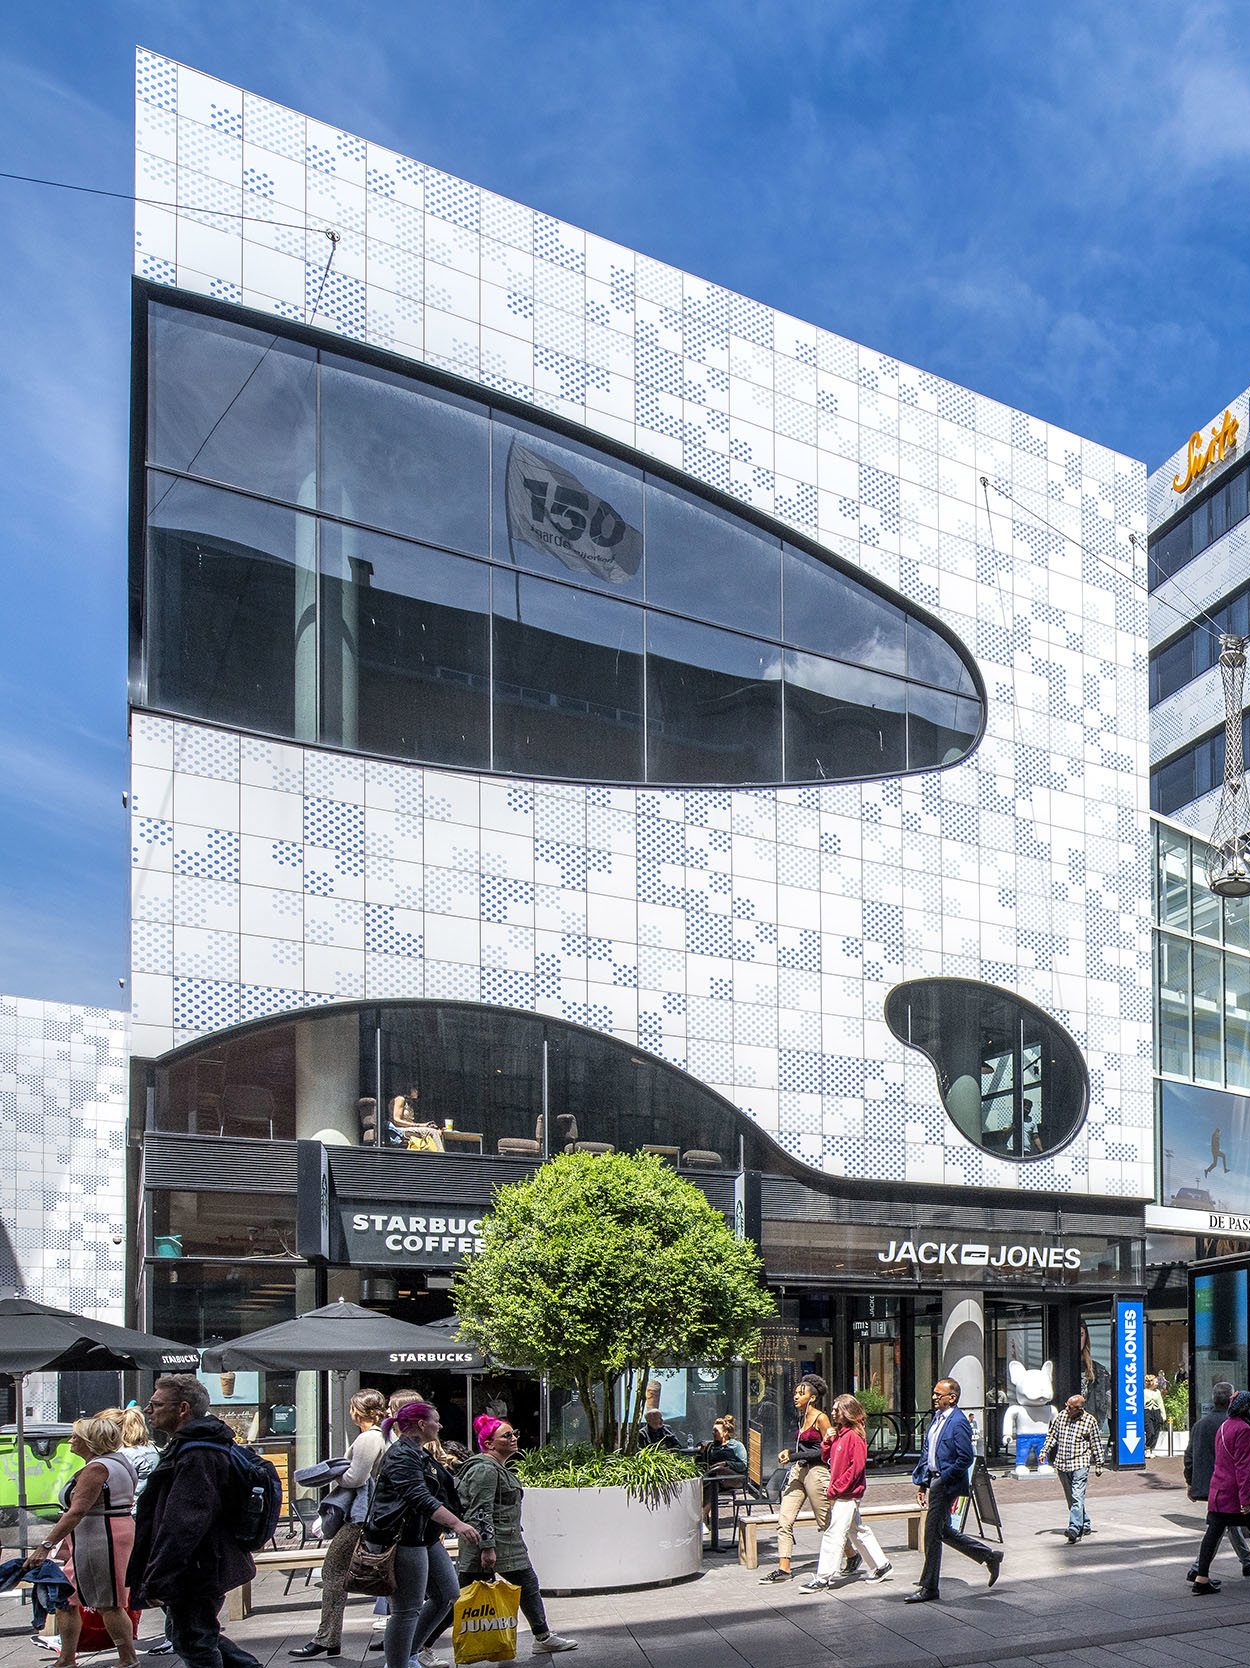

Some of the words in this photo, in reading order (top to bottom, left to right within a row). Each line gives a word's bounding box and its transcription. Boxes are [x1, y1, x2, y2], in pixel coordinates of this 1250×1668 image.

[1172, 410, 1240, 494] Suite
[524, 477, 626, 548] 150
[352, 1214, 485, 1235] STARBUC
[1209, 1215, 1225, 1229] DE
[385, 1234, 487, 1253] COFFEE
[878, 1241, 959, 1265] JACK
[990, 1245, 1081, 1269] JONES
[389, 1353, 473, 1362] STARBUCKS
[1124, 1309, 1137, 1415] JACK&JONES
[461, 1604, 496, 1619] Hallo
[458, 1615, 518, 1635] JUMBO
